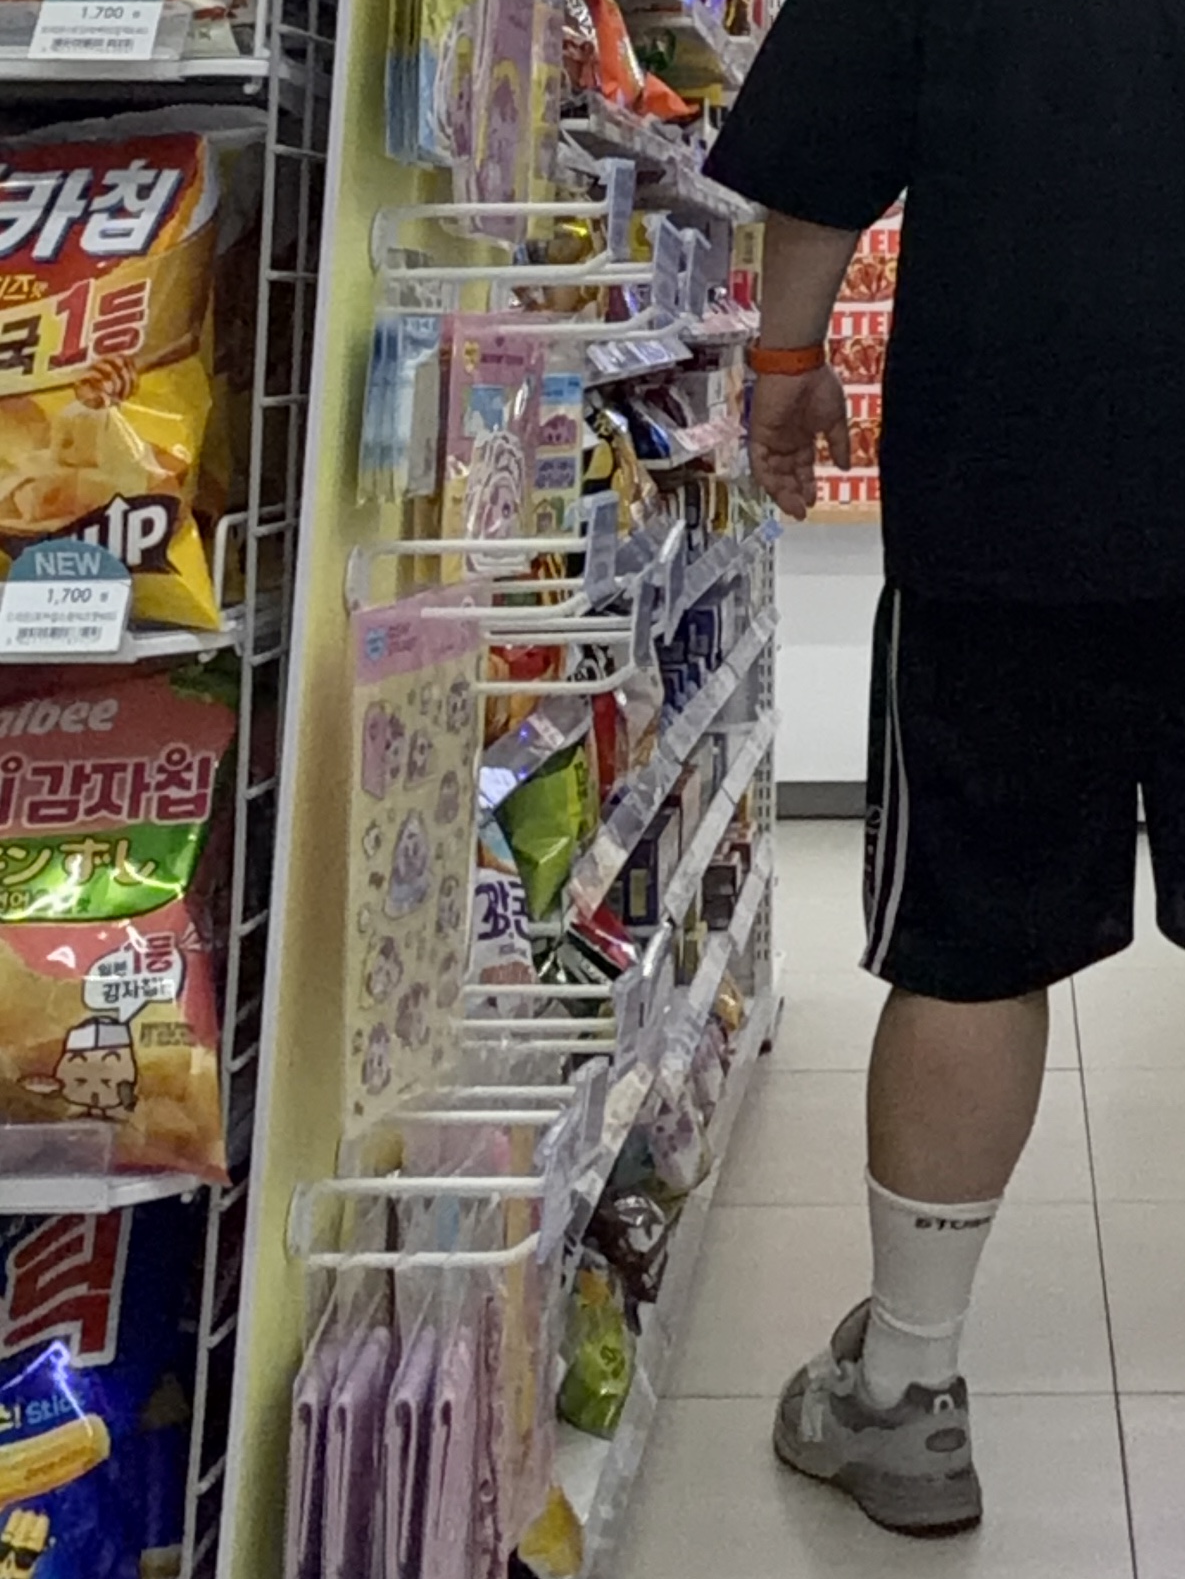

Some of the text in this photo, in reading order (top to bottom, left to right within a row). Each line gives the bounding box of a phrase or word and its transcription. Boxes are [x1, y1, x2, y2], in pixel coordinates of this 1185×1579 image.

[0, 157, 182, 263] 카칩
[48, 277, 153, 372] 1등
[34, 551, 102, 577] NEW
[46, 587, 92, 606] 1,700
